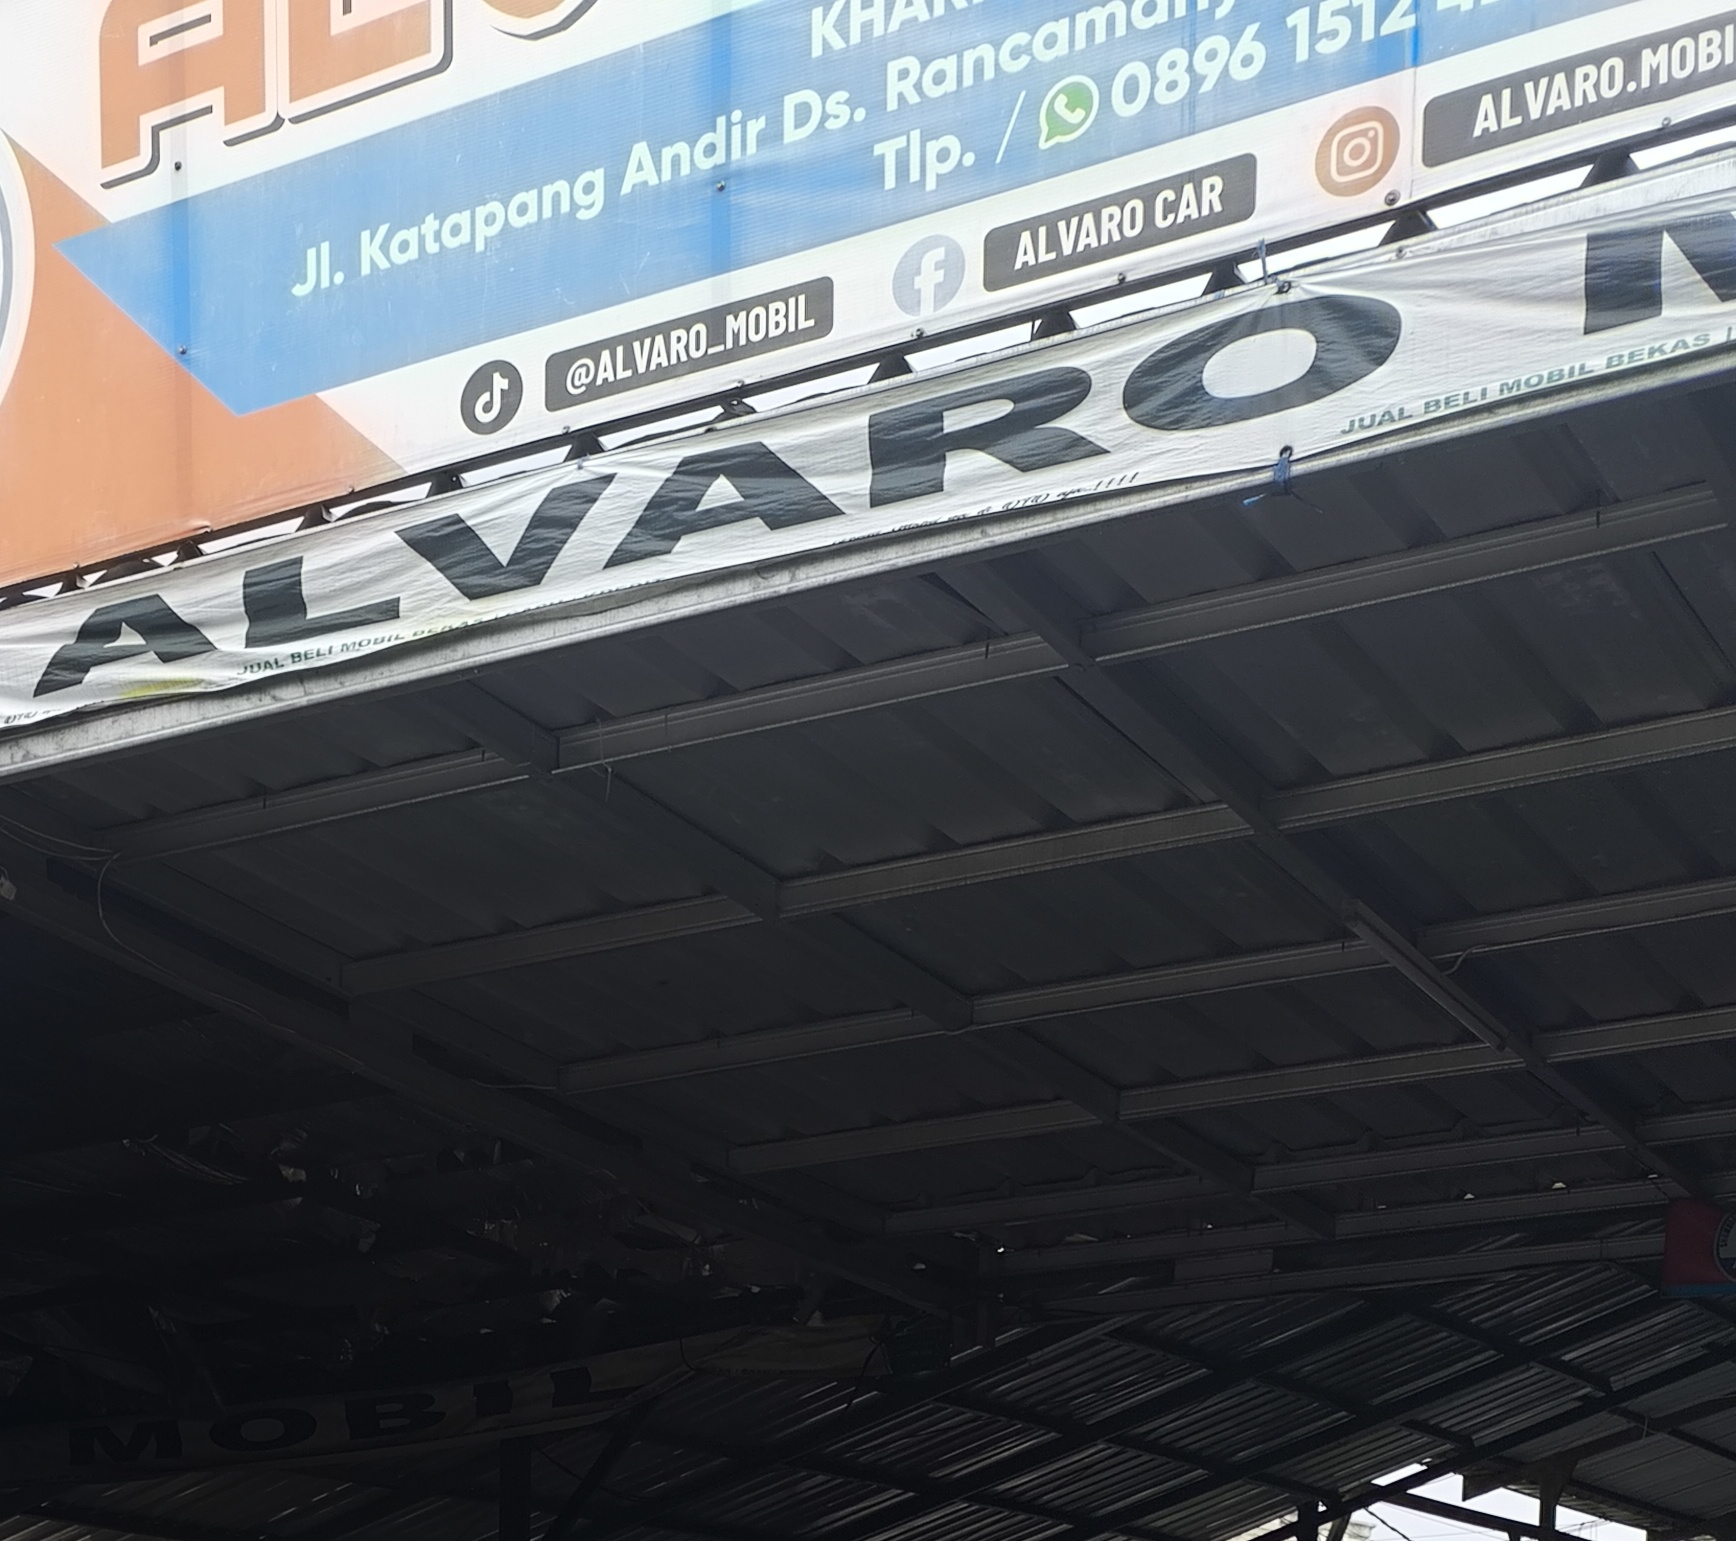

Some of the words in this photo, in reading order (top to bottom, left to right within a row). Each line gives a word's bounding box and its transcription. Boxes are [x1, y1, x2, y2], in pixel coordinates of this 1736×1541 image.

[1111, 22, 1267, 117] 0896
[360, 167, 605, 277] Katapang
[620, 109, 766, 196] Andir
[783, 88, 866, 144] Ds.
[1014, 198, 1144, 271] ALVARO
[1154, 175, 1224, 230] CAR
[565, 293, 816, 396] @ALVARO_MOBIL
[1340, 406, 1414, 435] JUAL
[1422, 387, 1488, 415] BELI
[1499, 362, 1595, 396] MOBIL
[1605, 333, 1711, 370] BEKAS
[32, 293, 1402, 699] ALVARO
[290, 645, 334, 665] BELI
